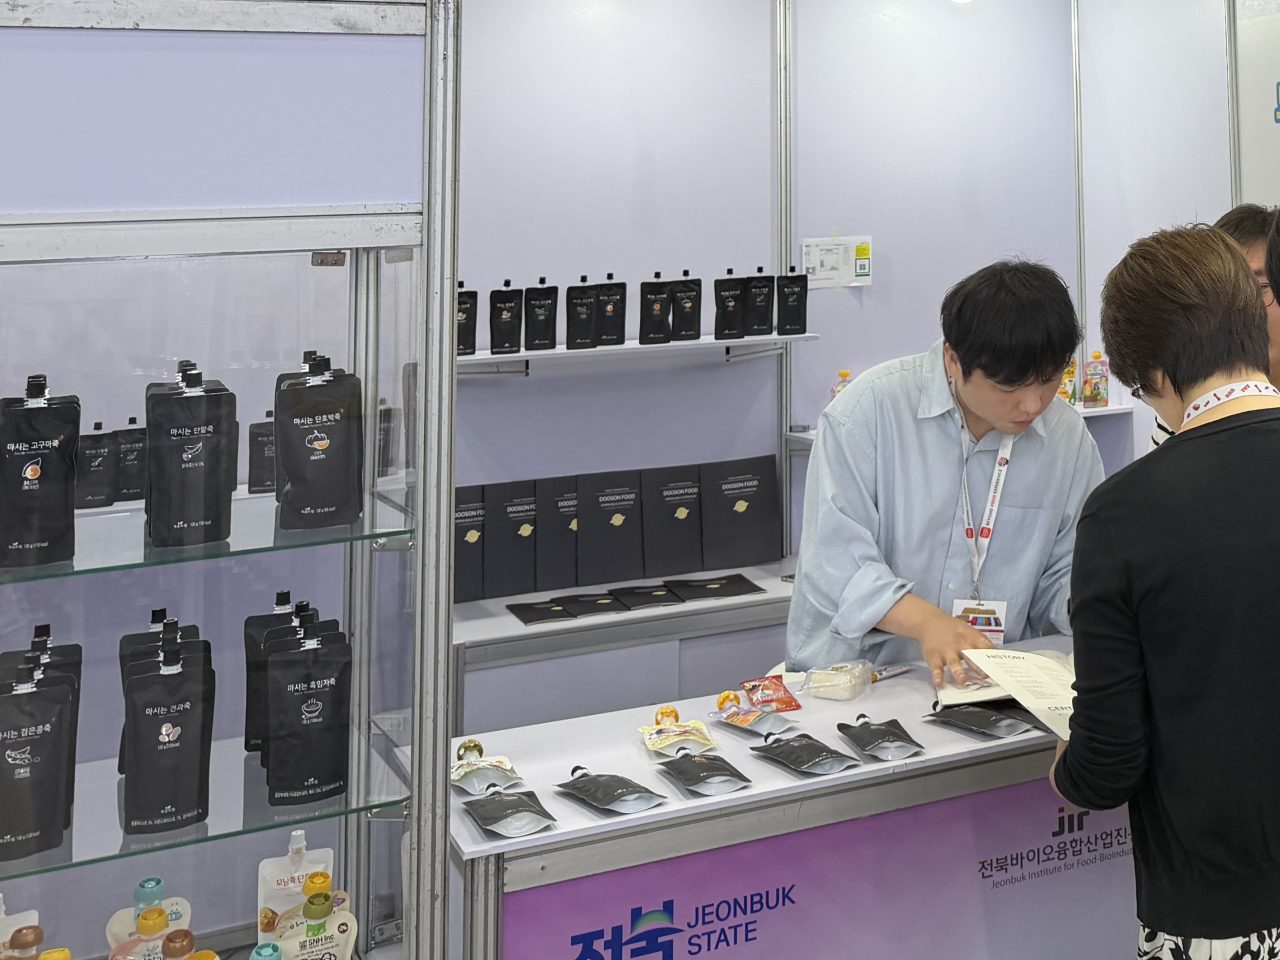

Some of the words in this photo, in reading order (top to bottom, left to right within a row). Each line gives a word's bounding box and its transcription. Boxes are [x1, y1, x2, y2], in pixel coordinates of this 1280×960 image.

[293, 417, 314, 426] 마시는
[170, 427, 192, 436] 마시는
[7, 442, 30, 452] 마시는
[558, 499, 577, 507] DOOSO
[287, 683, 308, 692] 마시는
[145, 706, 168, 716] 마시는
[977, 826, 1132, 880] 전북바이오융합산업진
[991, 873, 1027, 890] Jeonbuk
[1028, 864, 1062, 880] Institute
[1063, 860, 1075, 871] for
[686, 883, 797, 929] JEONBUK
[687, 919, 758, 956] STATE
